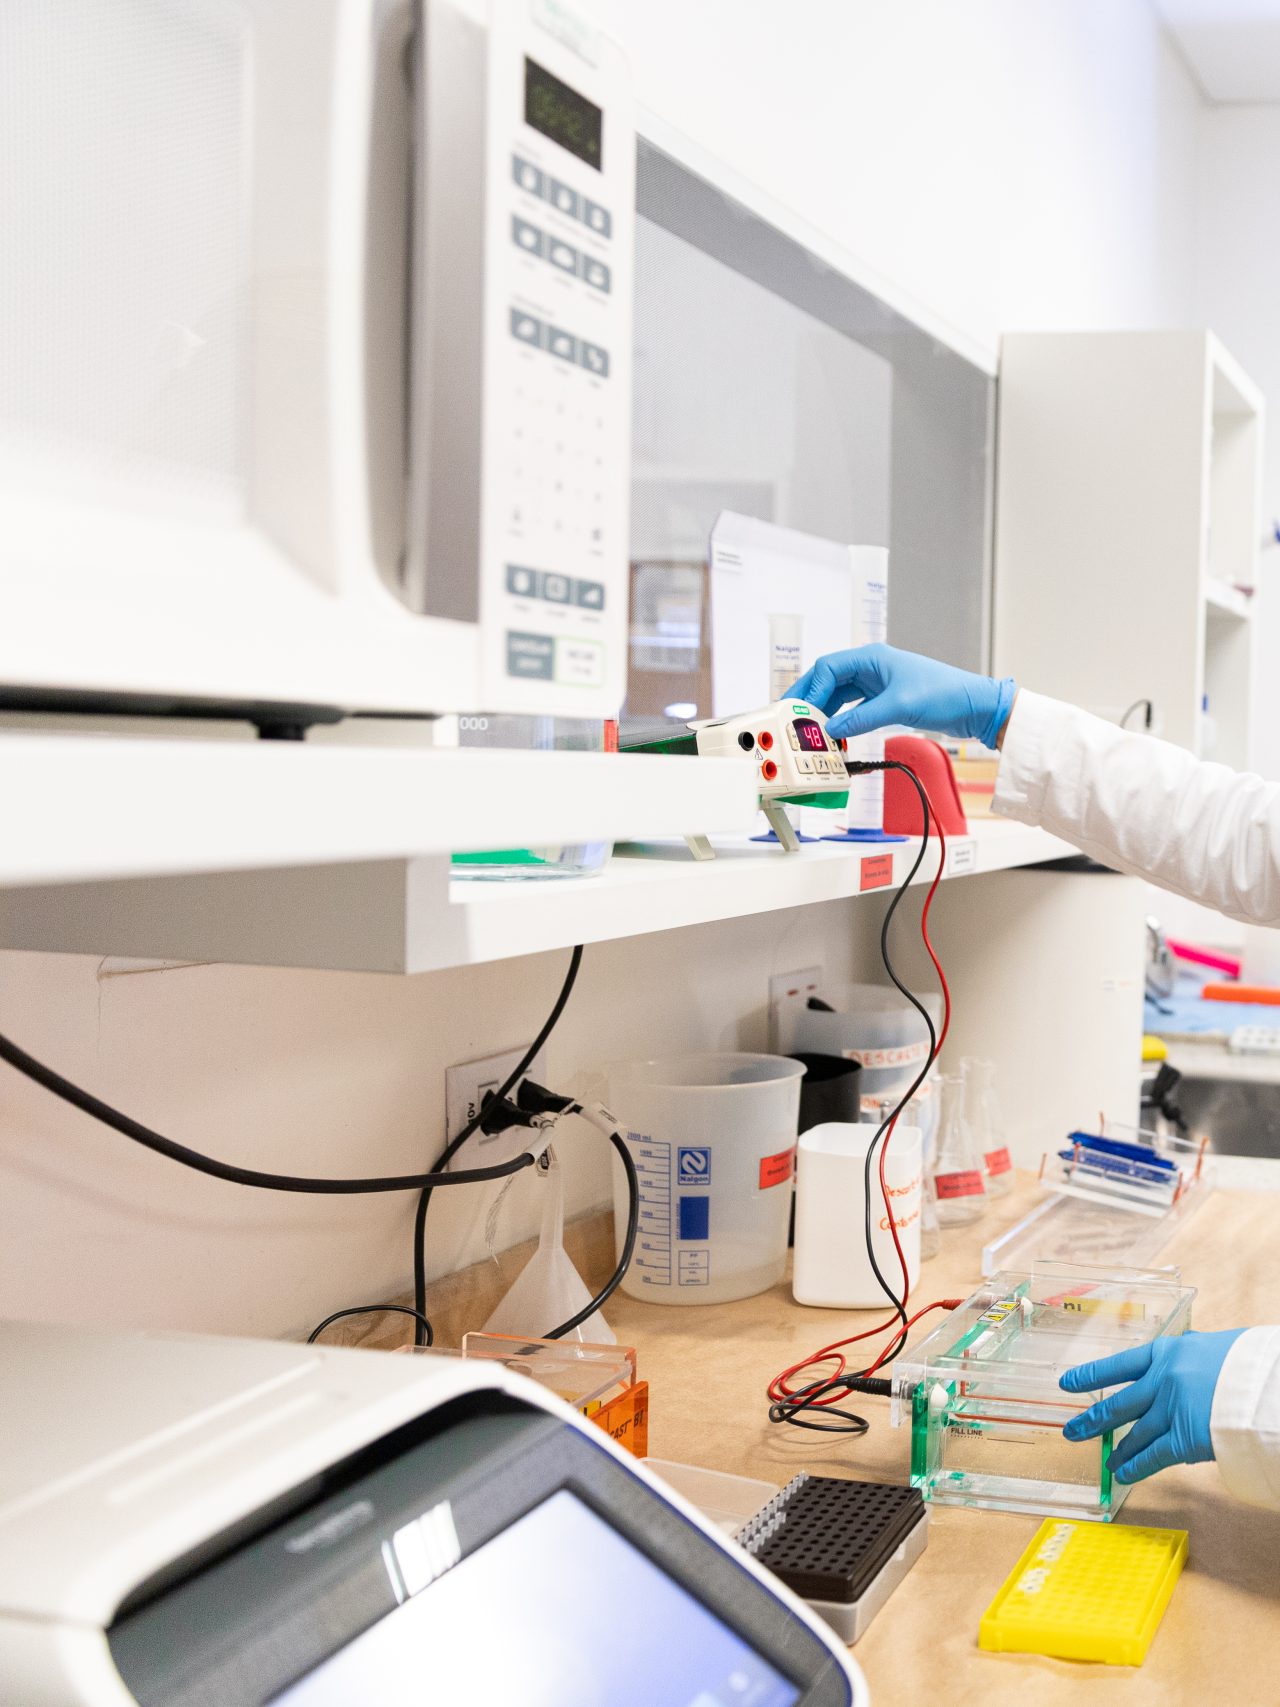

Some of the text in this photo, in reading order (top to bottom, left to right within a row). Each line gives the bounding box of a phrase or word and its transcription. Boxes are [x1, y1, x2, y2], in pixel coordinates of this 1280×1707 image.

[803, 726, 823, 748] 48
[633, 1409, 644, 1428] BT
[950, 1427, 983, 1436] FILL LINE
